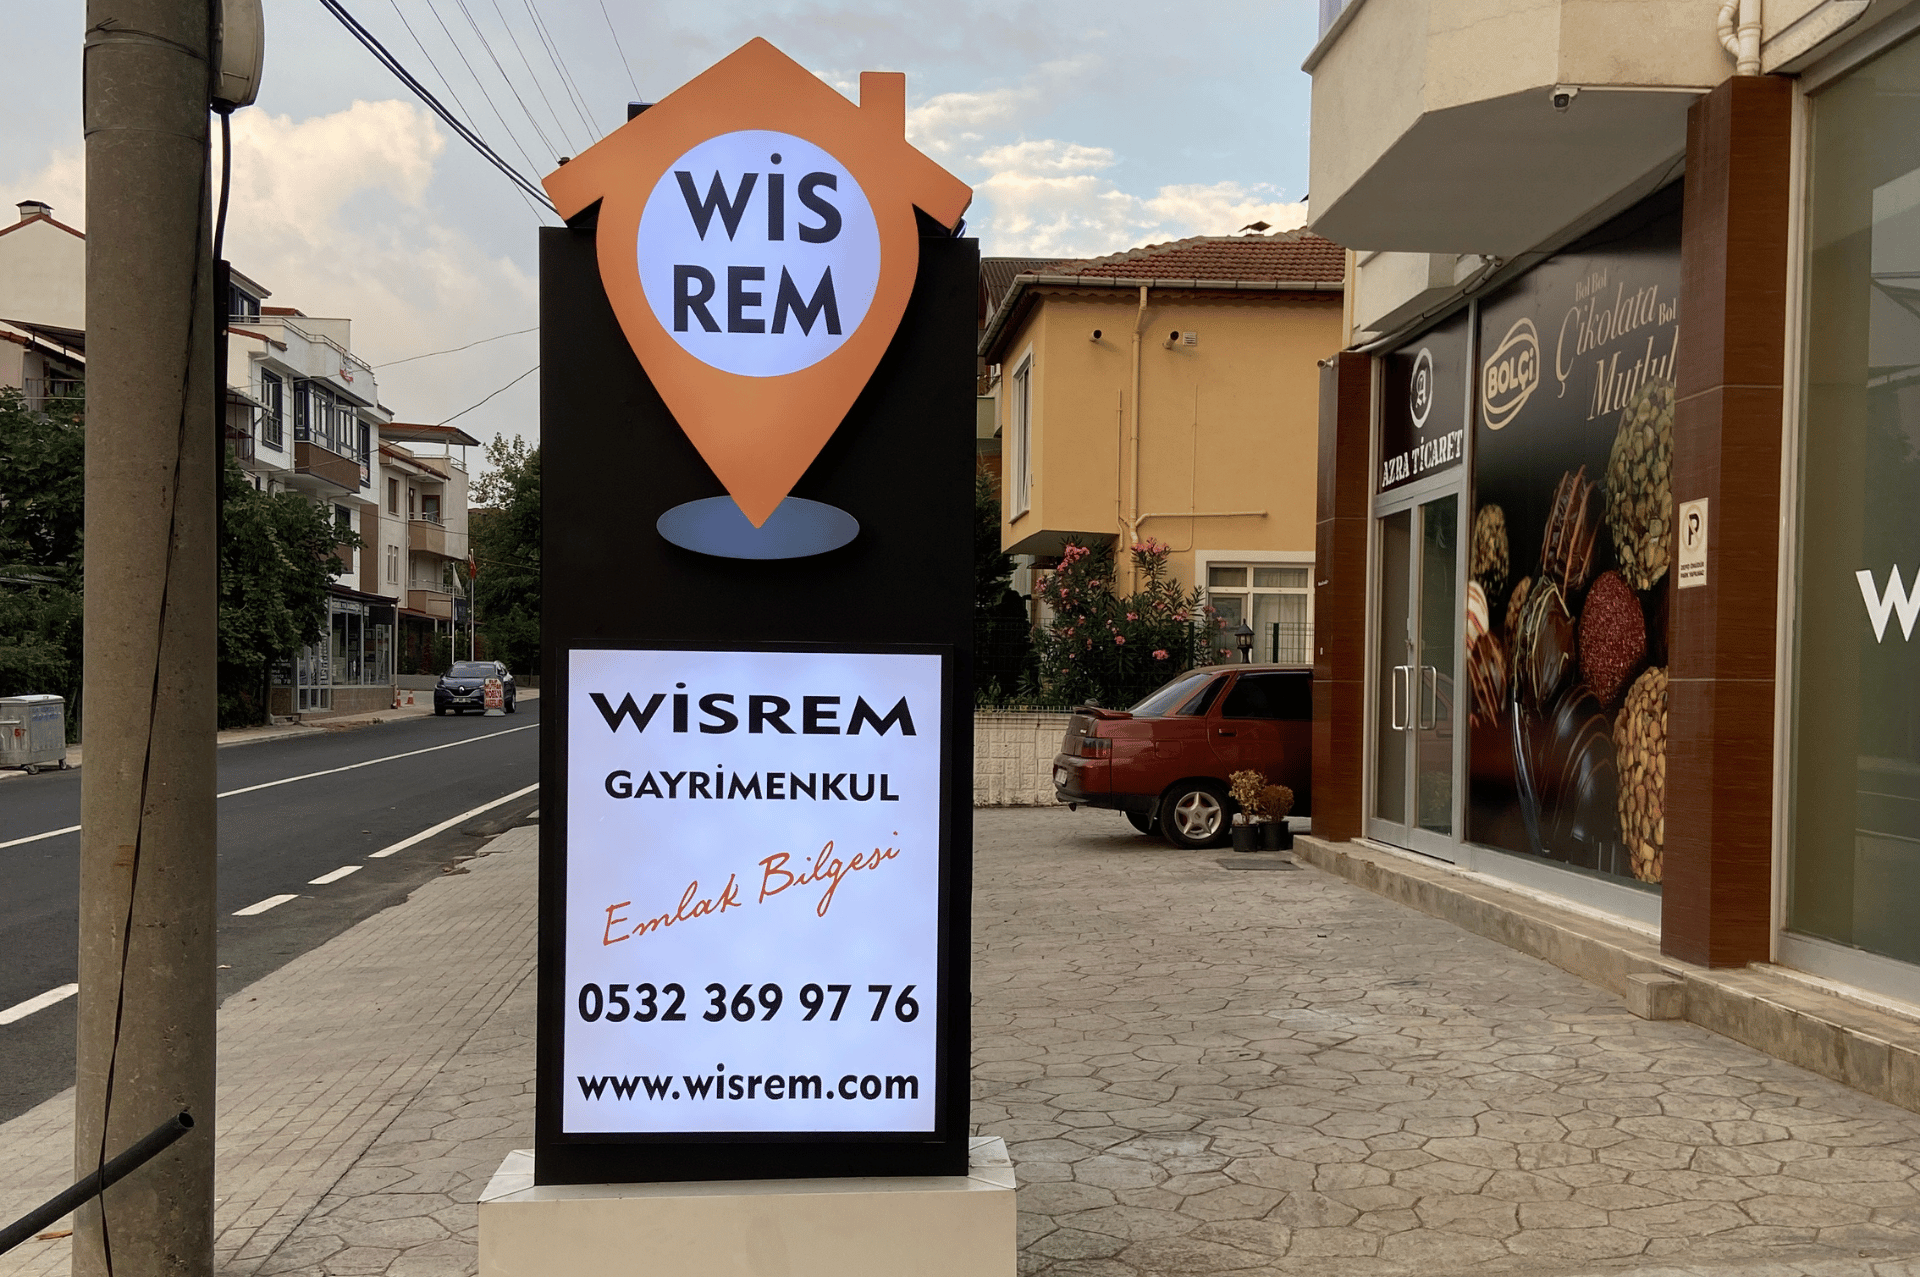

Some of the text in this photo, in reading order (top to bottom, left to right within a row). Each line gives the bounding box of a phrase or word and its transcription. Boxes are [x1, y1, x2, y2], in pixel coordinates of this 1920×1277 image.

[673, 264, 843, 338] REM
[1575, 267, 1608, 302] Bol Bol
[1555, 281, 1677, 398] Çikolata Bol
[1586, 324, 1680, 421] Mutlul
[1381, 428, 1463, 488] AZRA TİCARET
[588, 682, 917, 737] WİSREM
[604, 763, 900, 802] GAYRİMENKUL
[602, 831, 901, 946] Emlak Bilgesi
[578, 982, 920, 1023] 0532 369 97 76
[577, 1062, 920, 1102] www.wisrem.com
